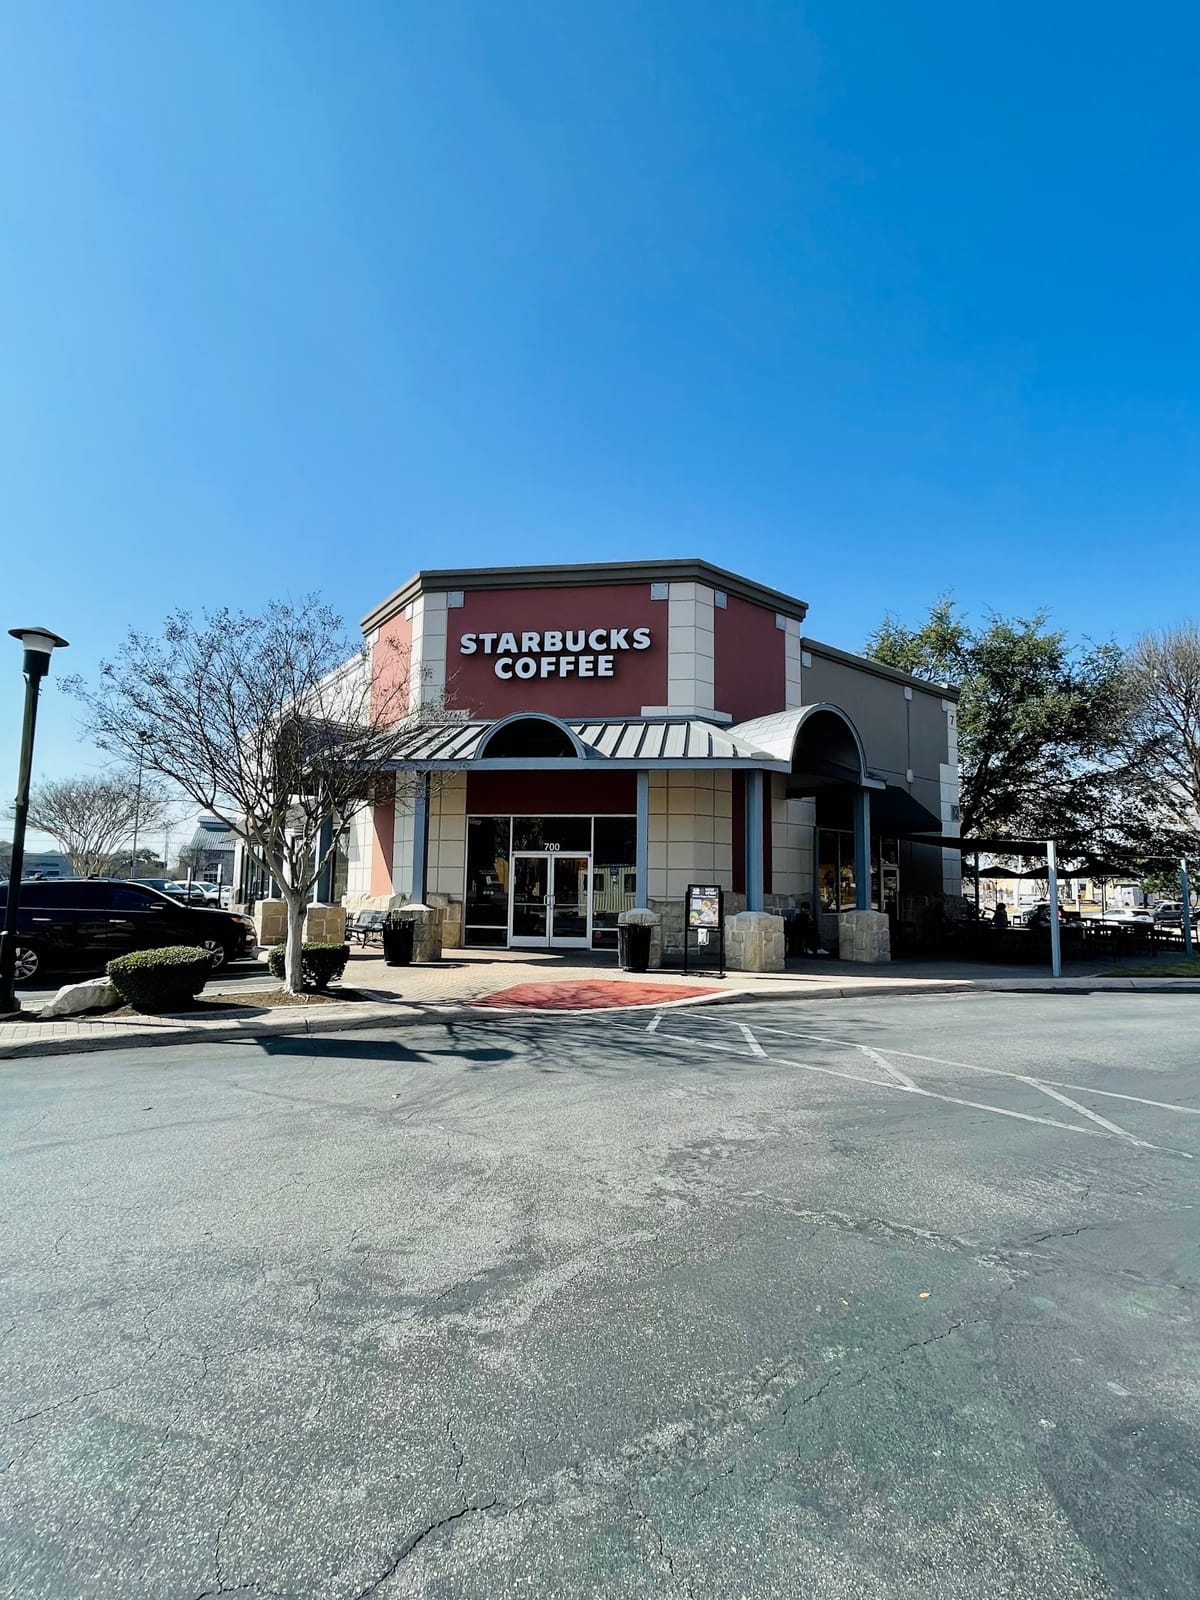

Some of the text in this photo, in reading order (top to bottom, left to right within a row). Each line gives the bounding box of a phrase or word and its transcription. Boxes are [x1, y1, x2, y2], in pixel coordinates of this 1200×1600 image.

[460, 627, 651, 654] STARBUCKS
[494, 655, 614, 679] COFFEE
[543, 842, 561, 851] 700
